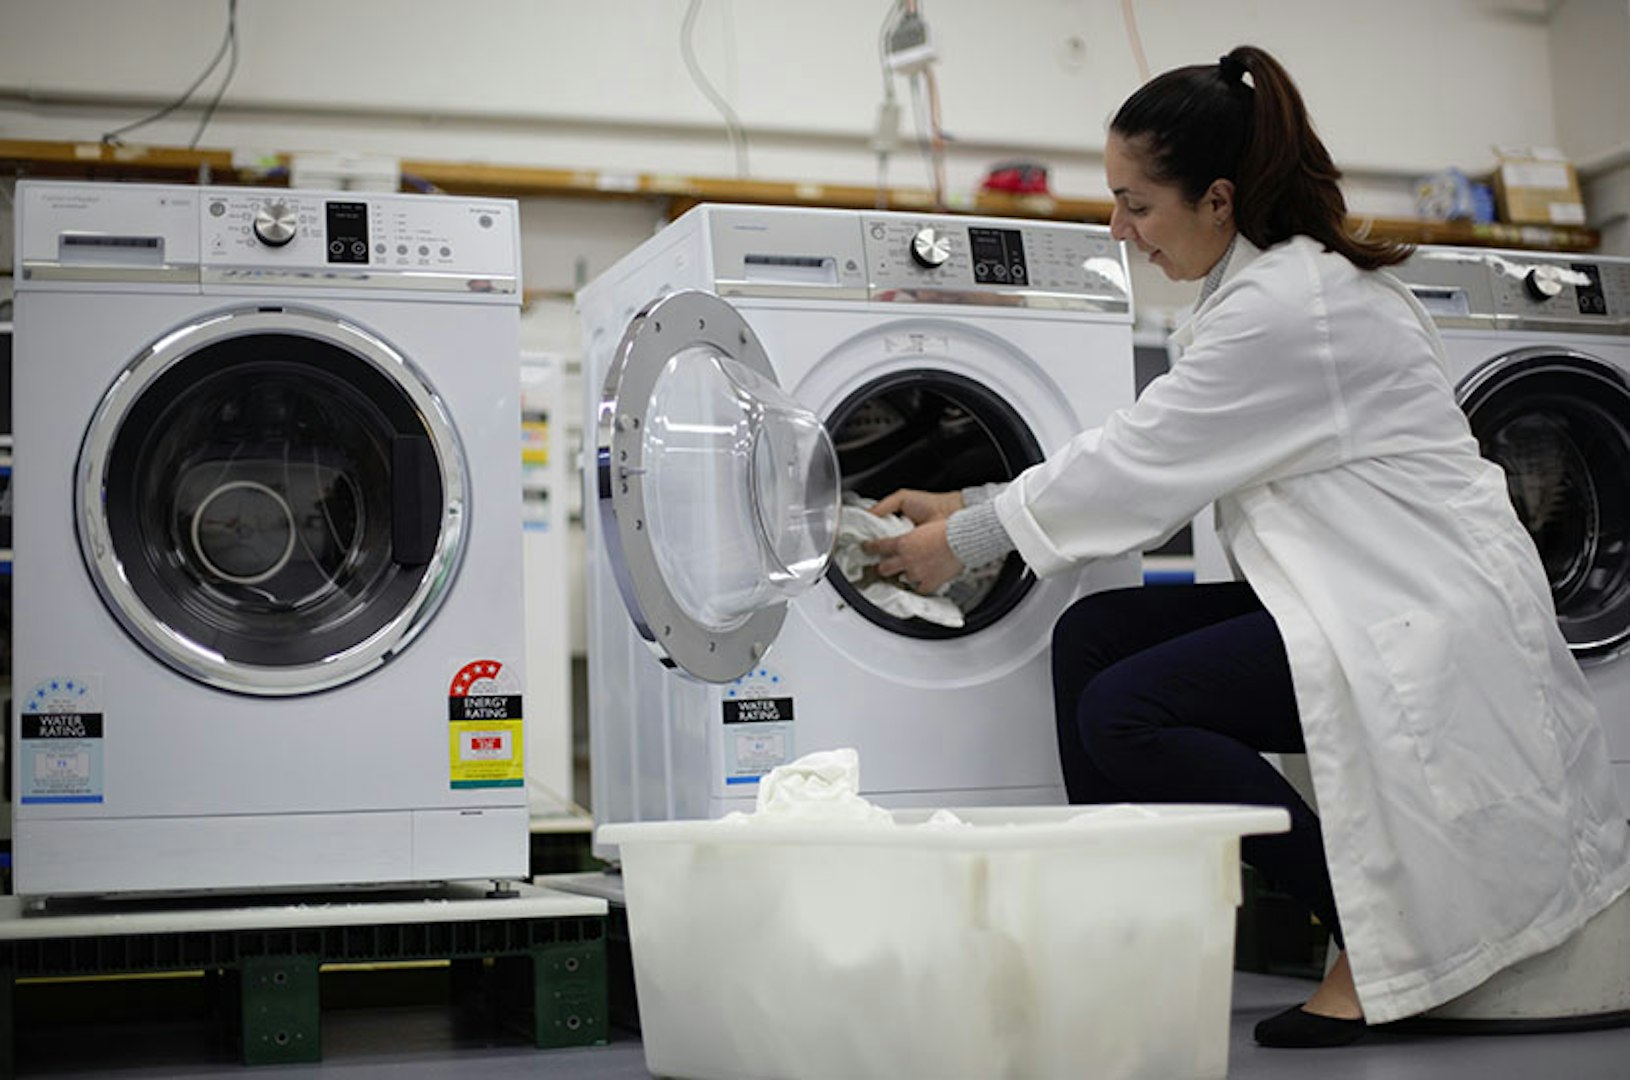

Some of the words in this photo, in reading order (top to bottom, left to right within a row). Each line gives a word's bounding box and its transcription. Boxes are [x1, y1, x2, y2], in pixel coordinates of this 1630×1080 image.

[464, 697, 508, 708] ENERGY
[738, 701, 775, 711] WATER
[465, 708, 508, 719] RATING
[738, 710, 780, 721] RATING
[39, 715, 82, 726] WATER
[39, 725, 86, 737] RATING
